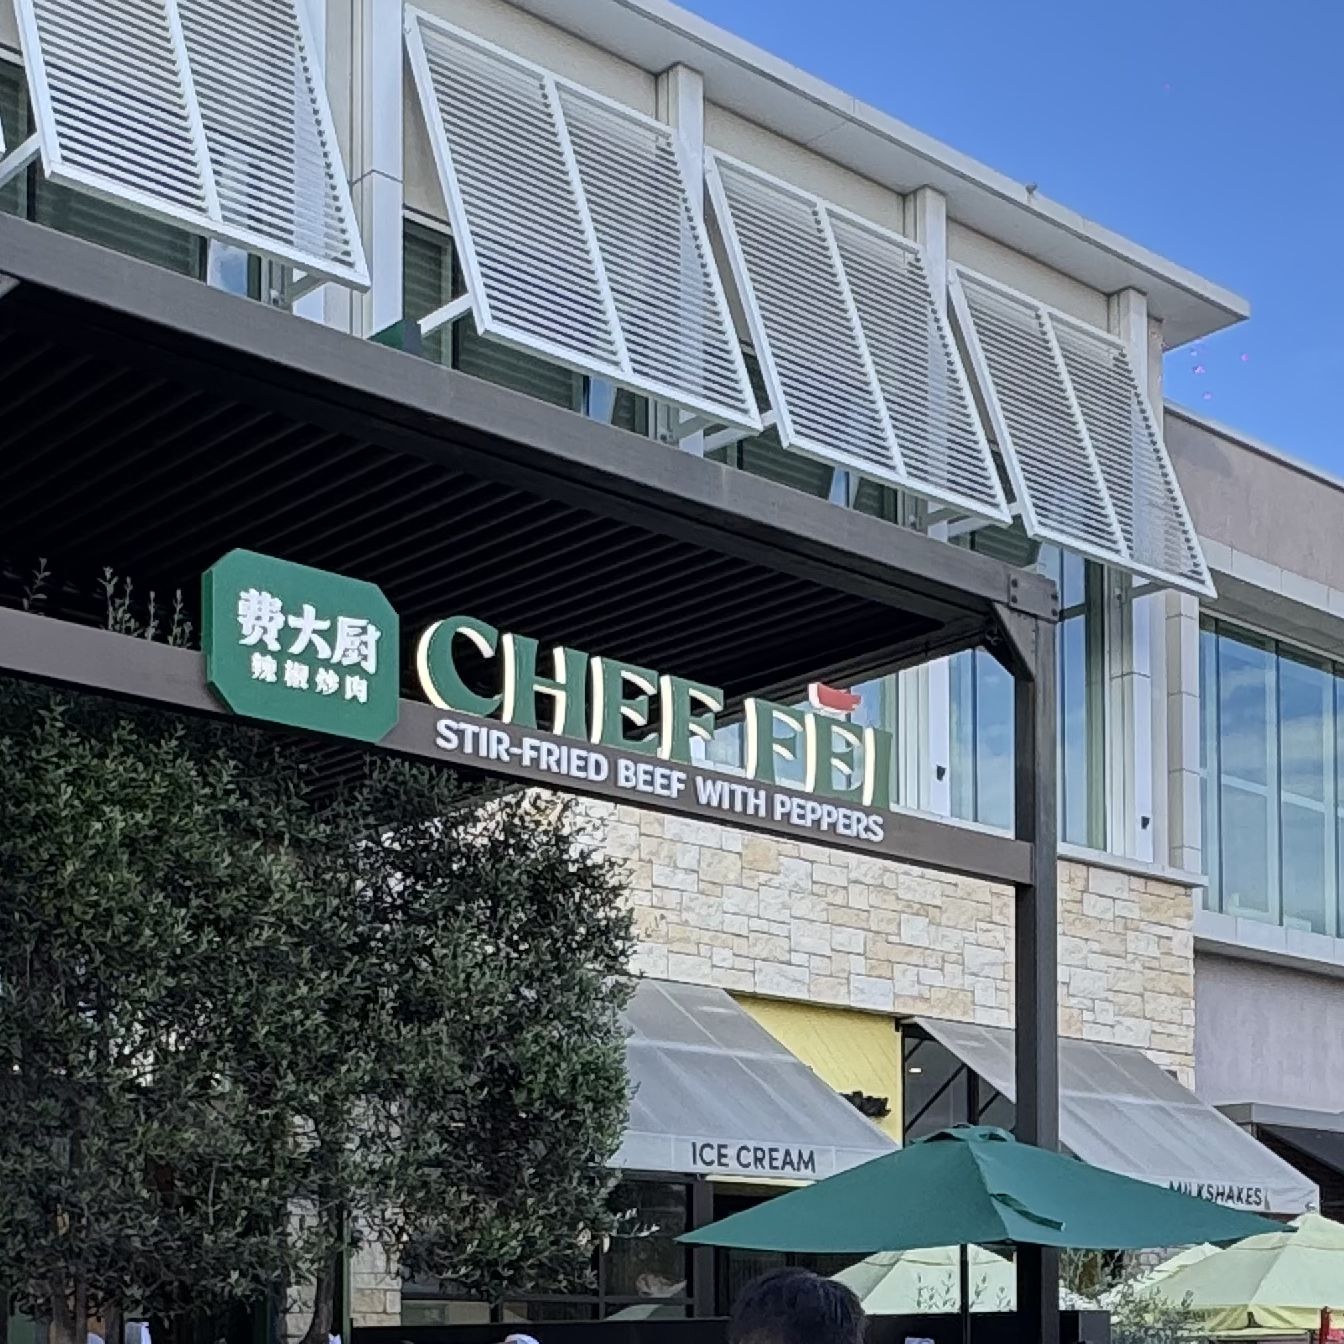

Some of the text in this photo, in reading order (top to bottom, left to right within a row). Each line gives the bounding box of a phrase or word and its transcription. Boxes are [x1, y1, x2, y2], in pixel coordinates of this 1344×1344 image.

[236, 587, 382, 675] 费大厨
[250, 651, 369, 704] 辣椒炒肉
[417, 615, 893, 809] CHEF FEI
[435, 719, 885, 843] STIR-FRIED BEEF WITH PEPPERS
[691, 1141, 816, 1174] ICE CREAM
